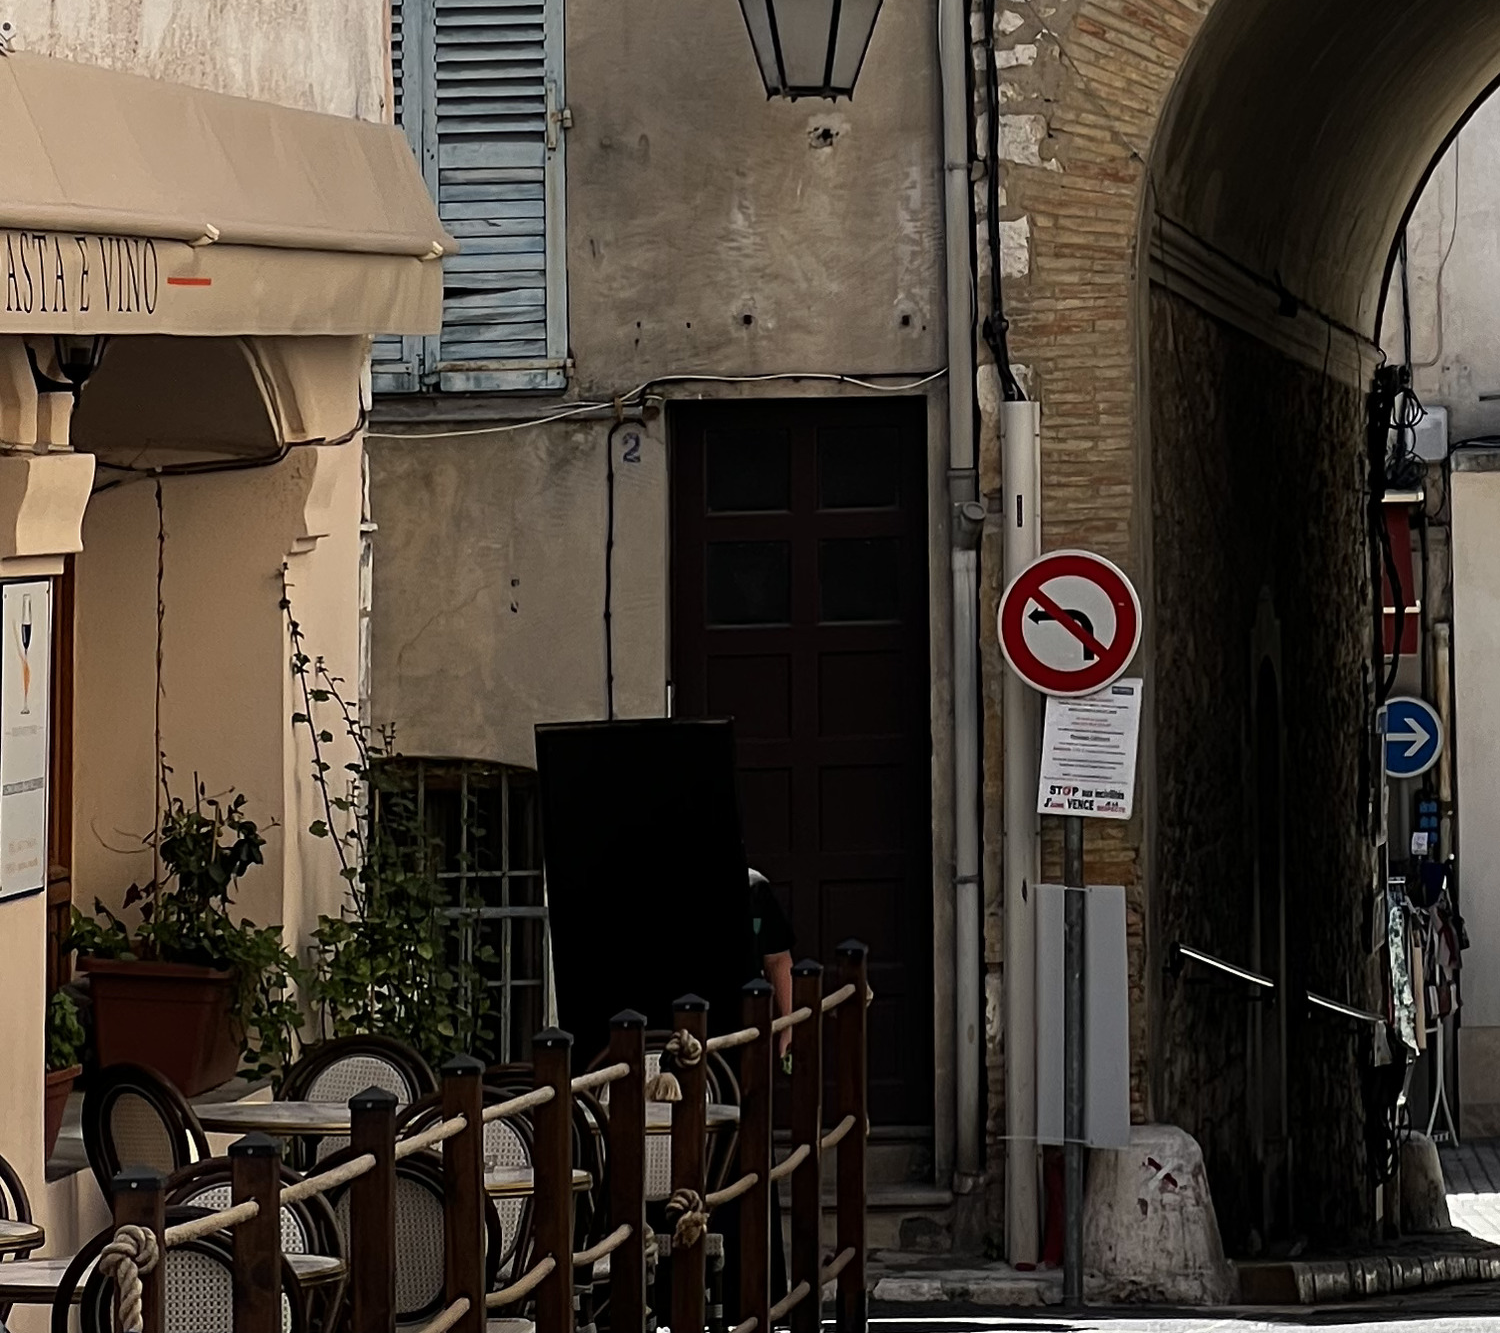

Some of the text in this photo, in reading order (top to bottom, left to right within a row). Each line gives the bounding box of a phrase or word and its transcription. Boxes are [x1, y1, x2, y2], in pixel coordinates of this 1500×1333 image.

[98, 237, 158, 314] VINO
[622, 432, 641, 462] 2
[1049, 785, 1079, 797] STOP
[1067, 798, 1094, 811] VENCE
